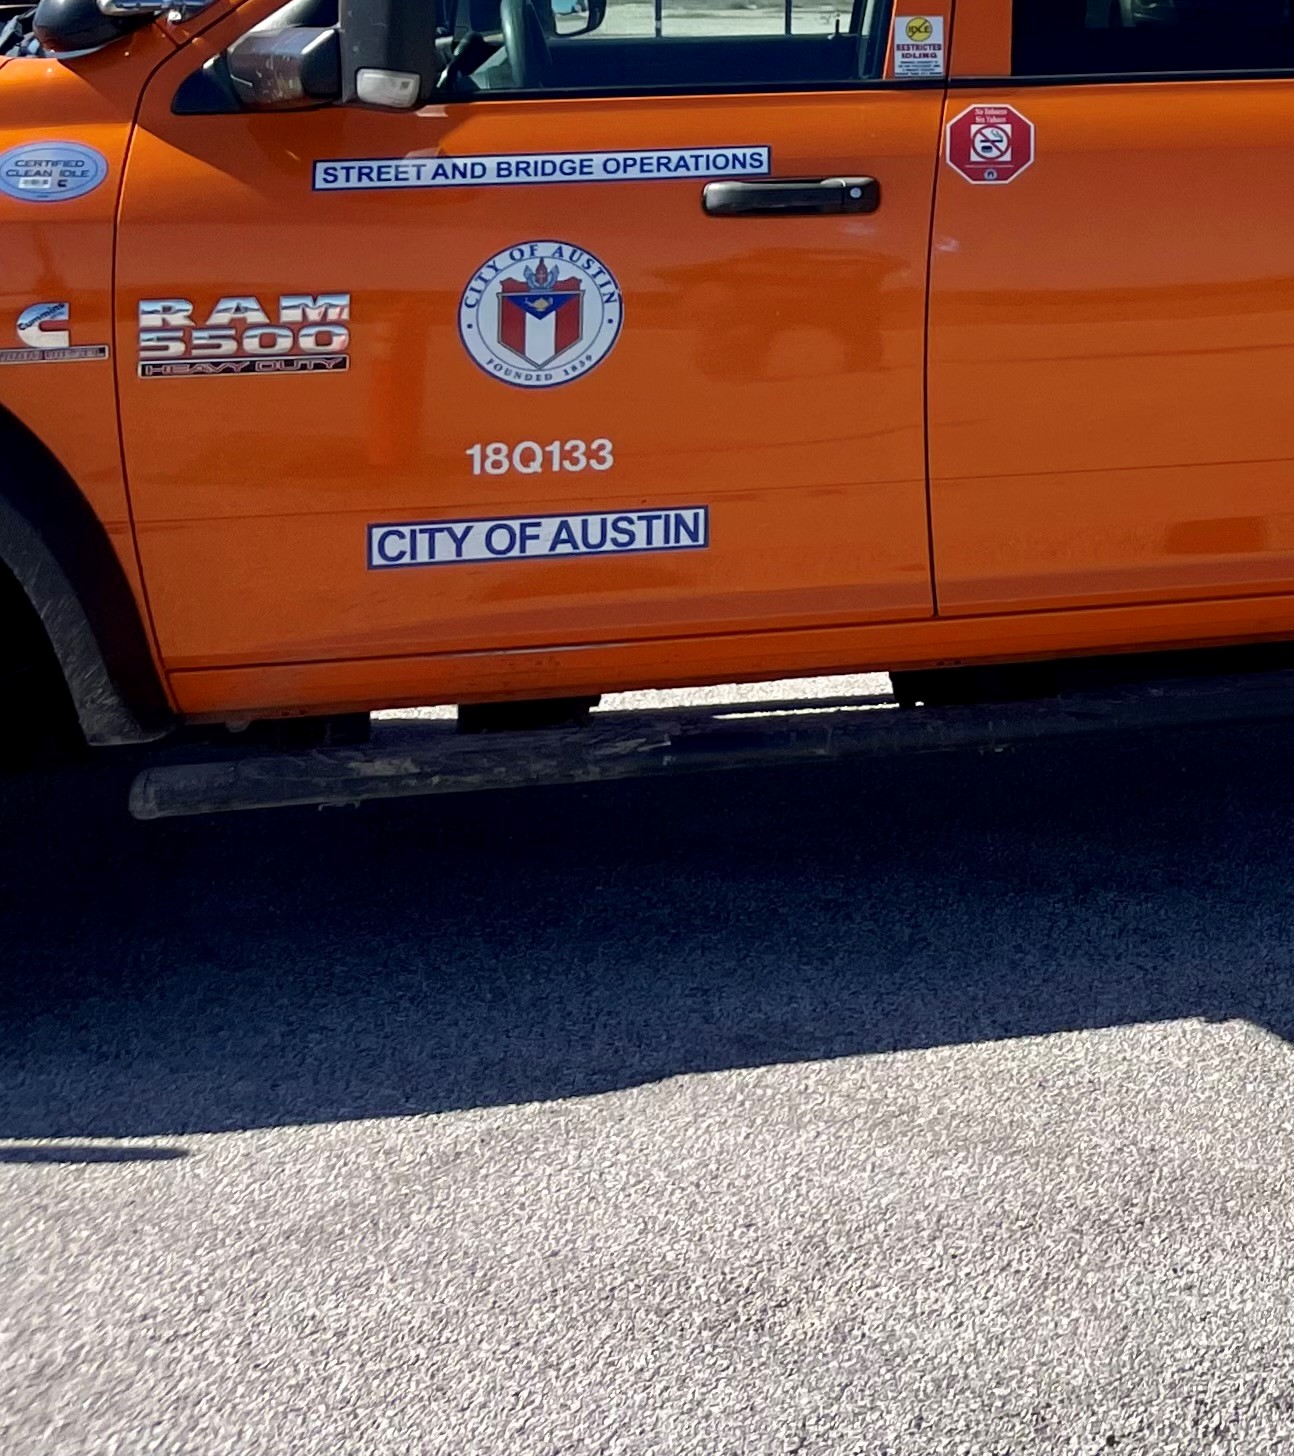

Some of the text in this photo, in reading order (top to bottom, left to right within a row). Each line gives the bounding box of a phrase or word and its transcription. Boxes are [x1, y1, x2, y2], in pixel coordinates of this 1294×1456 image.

[896, 43, 942, 51] RESTRICTED
[6, 169, 90, 177] CLEAN IDLE
[15, 160, 85, 168] CERTIFIED
[322, 151, 764, 184] STREET AND BRIDGE OPERATIONS
[464, 244, 618, 309] CITY OF AUSTIN
[17, 302, 65, 331] Cummins
[138, 294, 350, 327] RAM
[138, 323, 350, 359] 5500
[145, 357, 344, 376] HEAVY DUTY
[486, 354, 593, 382] FOUNDED 1839
[465, 438, 615, 475] 18Q133
[377, 511, 701, 563] CITY OF AUSTIN
